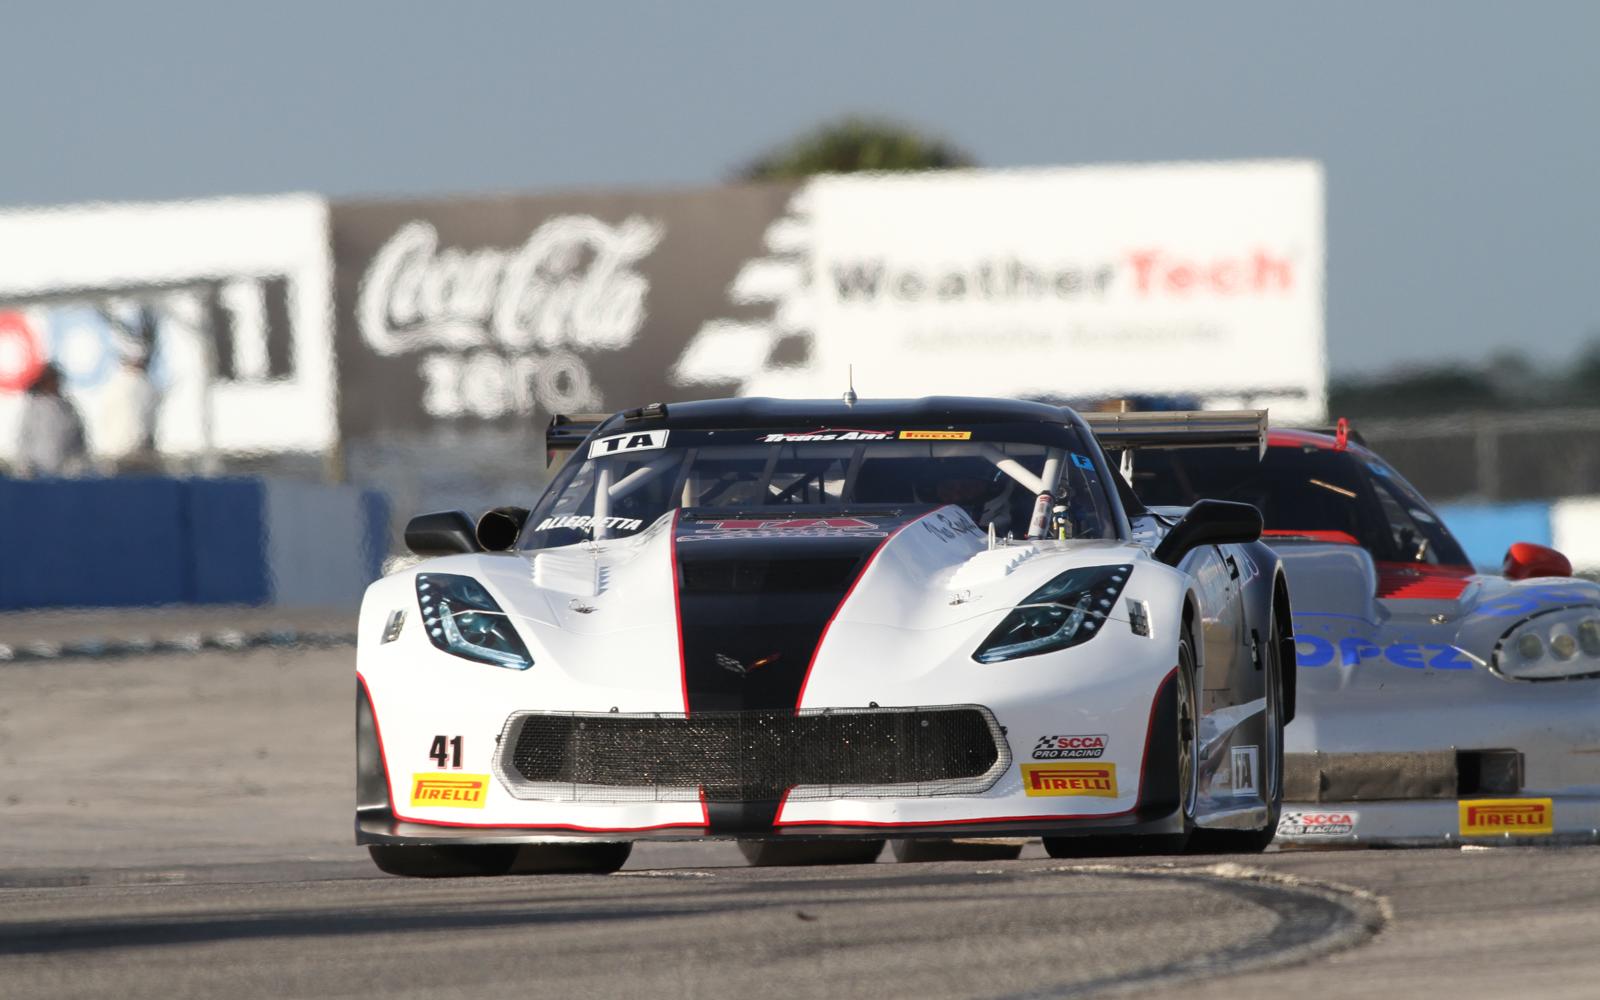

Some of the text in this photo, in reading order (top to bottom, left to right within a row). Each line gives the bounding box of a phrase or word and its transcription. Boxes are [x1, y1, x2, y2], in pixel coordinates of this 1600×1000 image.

[602, 433, 655, 451] TA
[763, 431, 888, 443] Trans Am
[1057, 737, 1104, 749] SCCA
[429, 735, 464, 770] 41
[1034, 749, 1102, 759] PRO RACING
[1030, 770, 1110, 791] PIRELLI
[414, 780, 482, 801] PIRELLI
[1302, 814, 1352, 825] SCCA
[1467, 804, 1544, 826] PIRELLI
